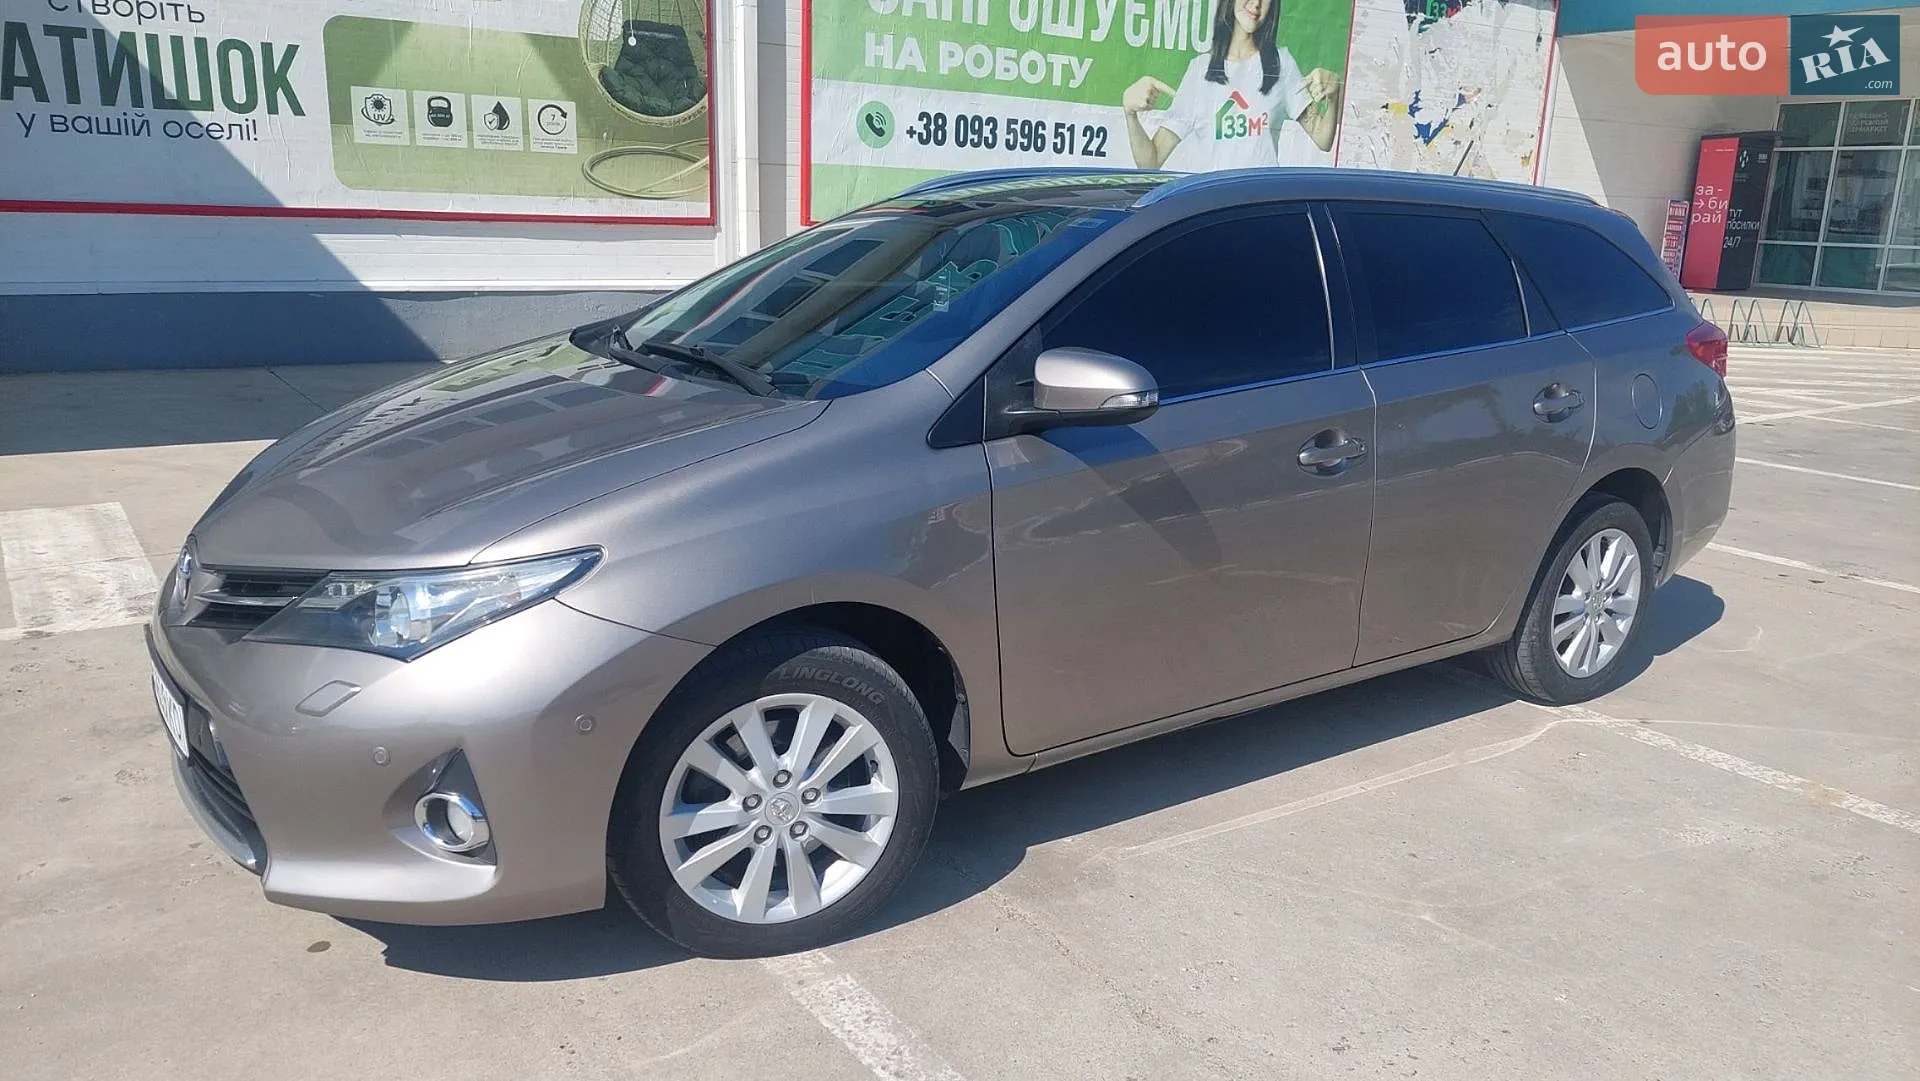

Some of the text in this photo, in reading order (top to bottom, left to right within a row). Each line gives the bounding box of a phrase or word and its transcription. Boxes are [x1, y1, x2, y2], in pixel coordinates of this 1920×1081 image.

[867, 0, 1213, 54] ШУЄМО
[0, 21, 306, 117] АТИШОК
[864, 32, 1093, 89] НА РОБОТУ
[16, 112, 258, 141] у вашій оселі!
[906, 111, 1108, 158] +38 093 596 51 22
[1691, 210, 1722, 224] рай
[1708, 197, 1728, 209] би
[1723, 236, 1741, 248] 24/7
[780, 666, 886, 706] LINGLONG
